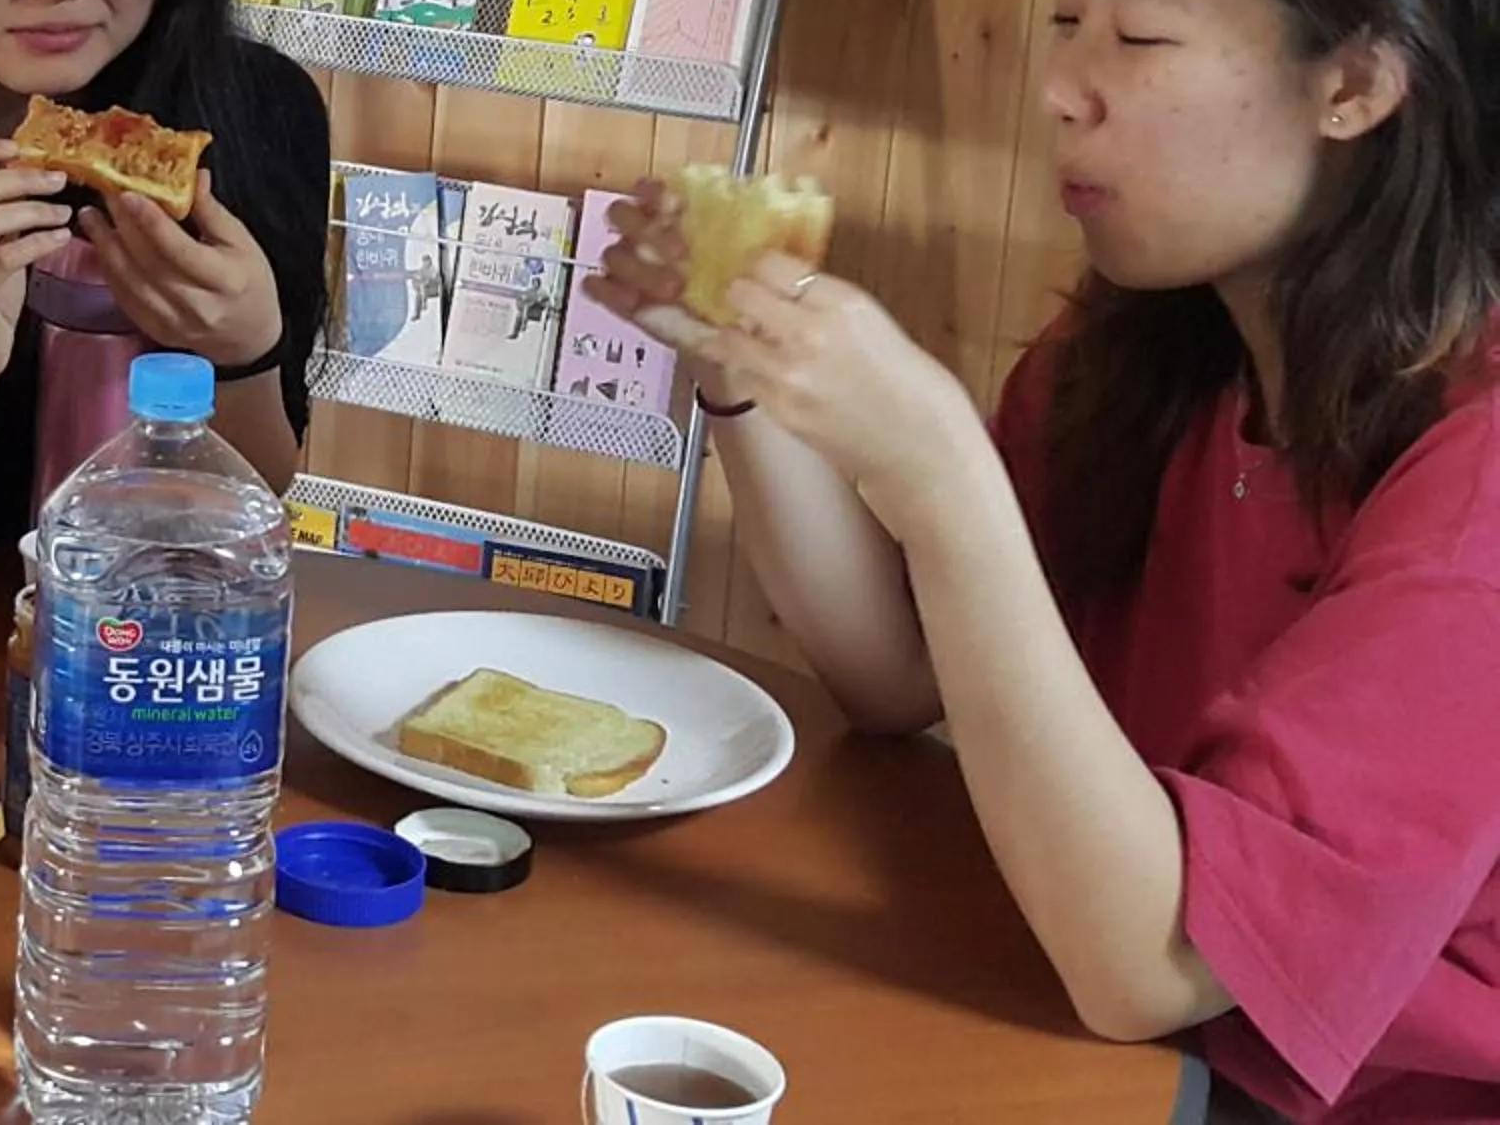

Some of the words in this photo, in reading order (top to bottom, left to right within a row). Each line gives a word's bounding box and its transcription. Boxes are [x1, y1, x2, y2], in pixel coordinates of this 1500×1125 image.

[102, 657, 265, 703] 동원샘물
[131, 707, 191, 722] mineral
[195, 706, 241, 722] water
